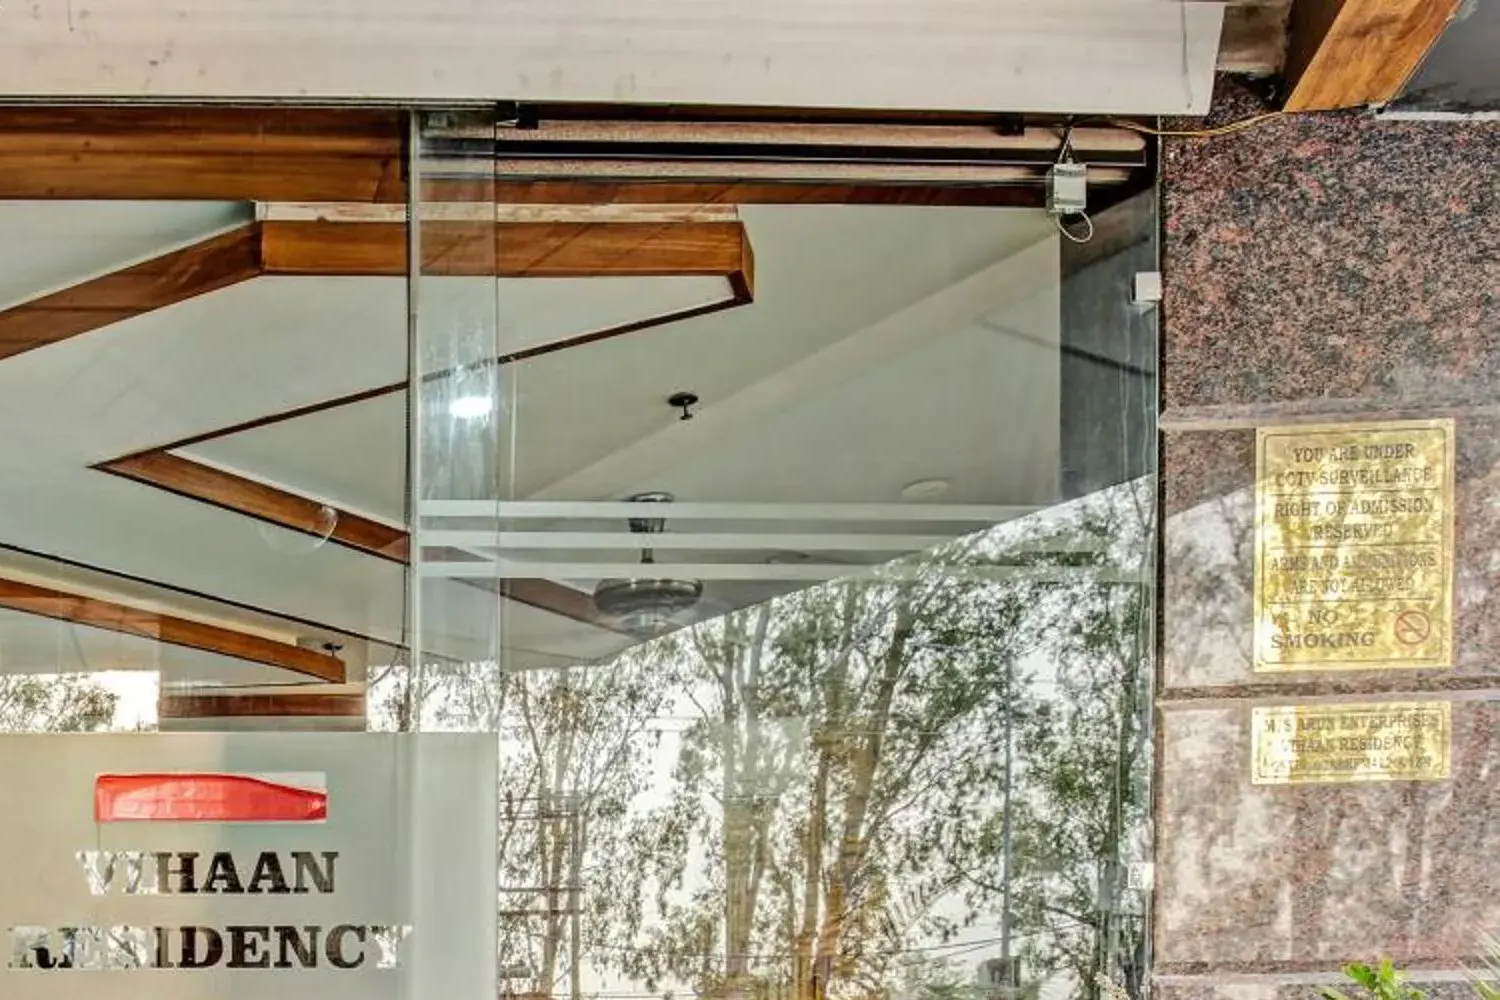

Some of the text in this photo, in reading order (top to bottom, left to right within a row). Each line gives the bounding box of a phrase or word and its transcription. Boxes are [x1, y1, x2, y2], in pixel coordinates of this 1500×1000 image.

[1294, 443, 1414, 463] YOU ARE UNDER
[1275, 466, 1432, 487] CCTV SURVEILLANCE
[1275, 496, 1434, 517] RIGHT OF ADMISSION
[1313, 523, 1393, 540] RESERVED
[1311, 554, 1339, 570] AND
[1308, 609, 1338, 625] NO
[1271, 632, 1375, 649] SMOKING
[75, 849, 339, 896] VIHAAN
[7, 923, 413, 970] RESIDENCY
